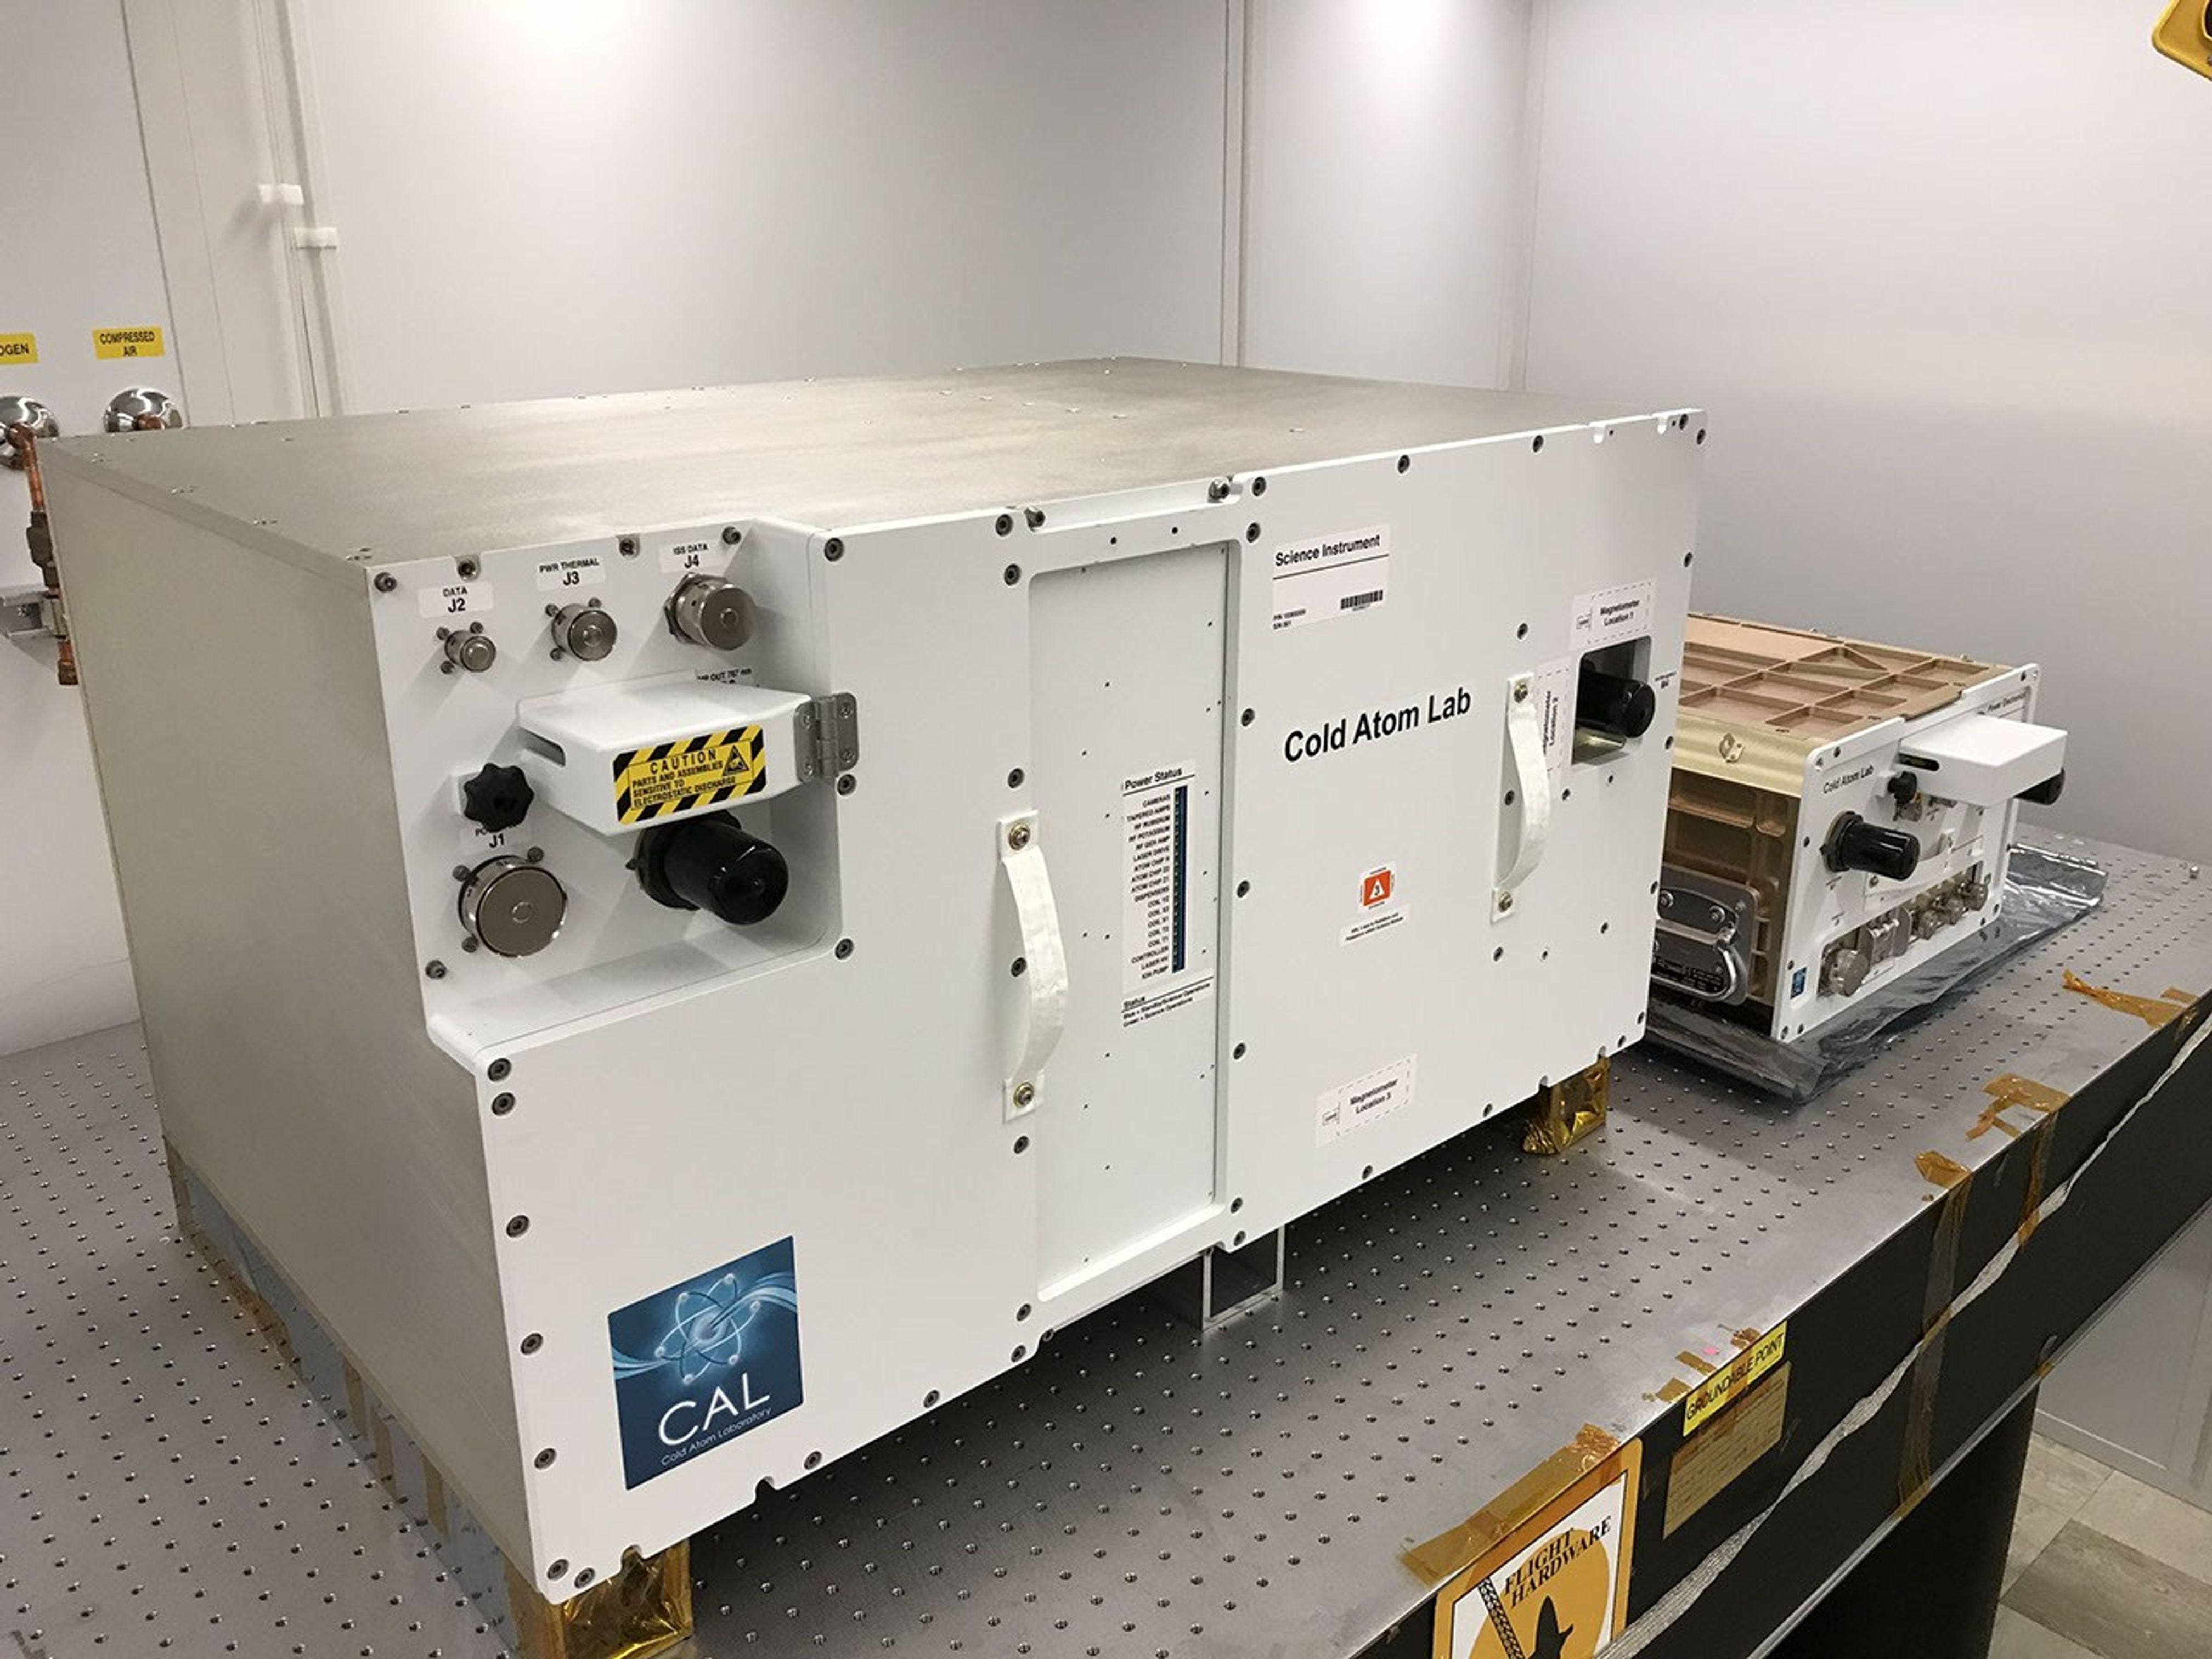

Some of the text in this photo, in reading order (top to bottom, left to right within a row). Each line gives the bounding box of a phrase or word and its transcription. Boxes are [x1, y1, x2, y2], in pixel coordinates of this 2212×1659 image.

[100, 331, 154, 344] COMPRESSED
[123, 346, 137, 356] AIR
[687, 543, 708, 553] DATA
[1276, 534, 1380, 566] Science Instrument
[539, 558, 599, 572] PWR THERMAL
[684, 555, 699, 568] J4
[563, 571, 579, 586] J3
[443, 586, 467, 597] DATA
[448, 597, 466, 613] J2
[1600, 600, 1640, 616] Magnetometer
[1604, 614, 1629, 626] Location
[1284, 687, 1471, 762] Cold Atom Lab
[1549, 705, 1557, 746] Location
[650, 749, 717, 774] CAUTION
[633, 760, 723, 788] PARTS AND ASSEMBLIES
[1125, 768, 1182, 790] Power Status
[1823, 765, 1874, 794] Cold Atom Lab
[633, 779, 685, 797] SENSITIVE TO
[634, 776, 736, 807] ELECTROSTATIC DISCHARGE
[489, 833, 504, 848] J1
[1134, 862, 1150, 872] ATOM
[1132, 873, 1148, 883] ATOM
[1131, 883, 1148, 893] ATOM
[1131, 945, 1169, 963] CONTROLLER
[1350, 1079, 1398, 1105] Magnetometer
[1356, 1096, 1385, 1114] Location
[1687, 1332, 1784, 1420] GROUNDABLE POINT
[658, 1373, 770, 1446] CAL
[661, 1408, 771, 1465] Cold Atom Laboratory
[1505, 1527, 1573, 1595] FLIGHT
[1512, 1515, 1611, 1609] HARDWARE
